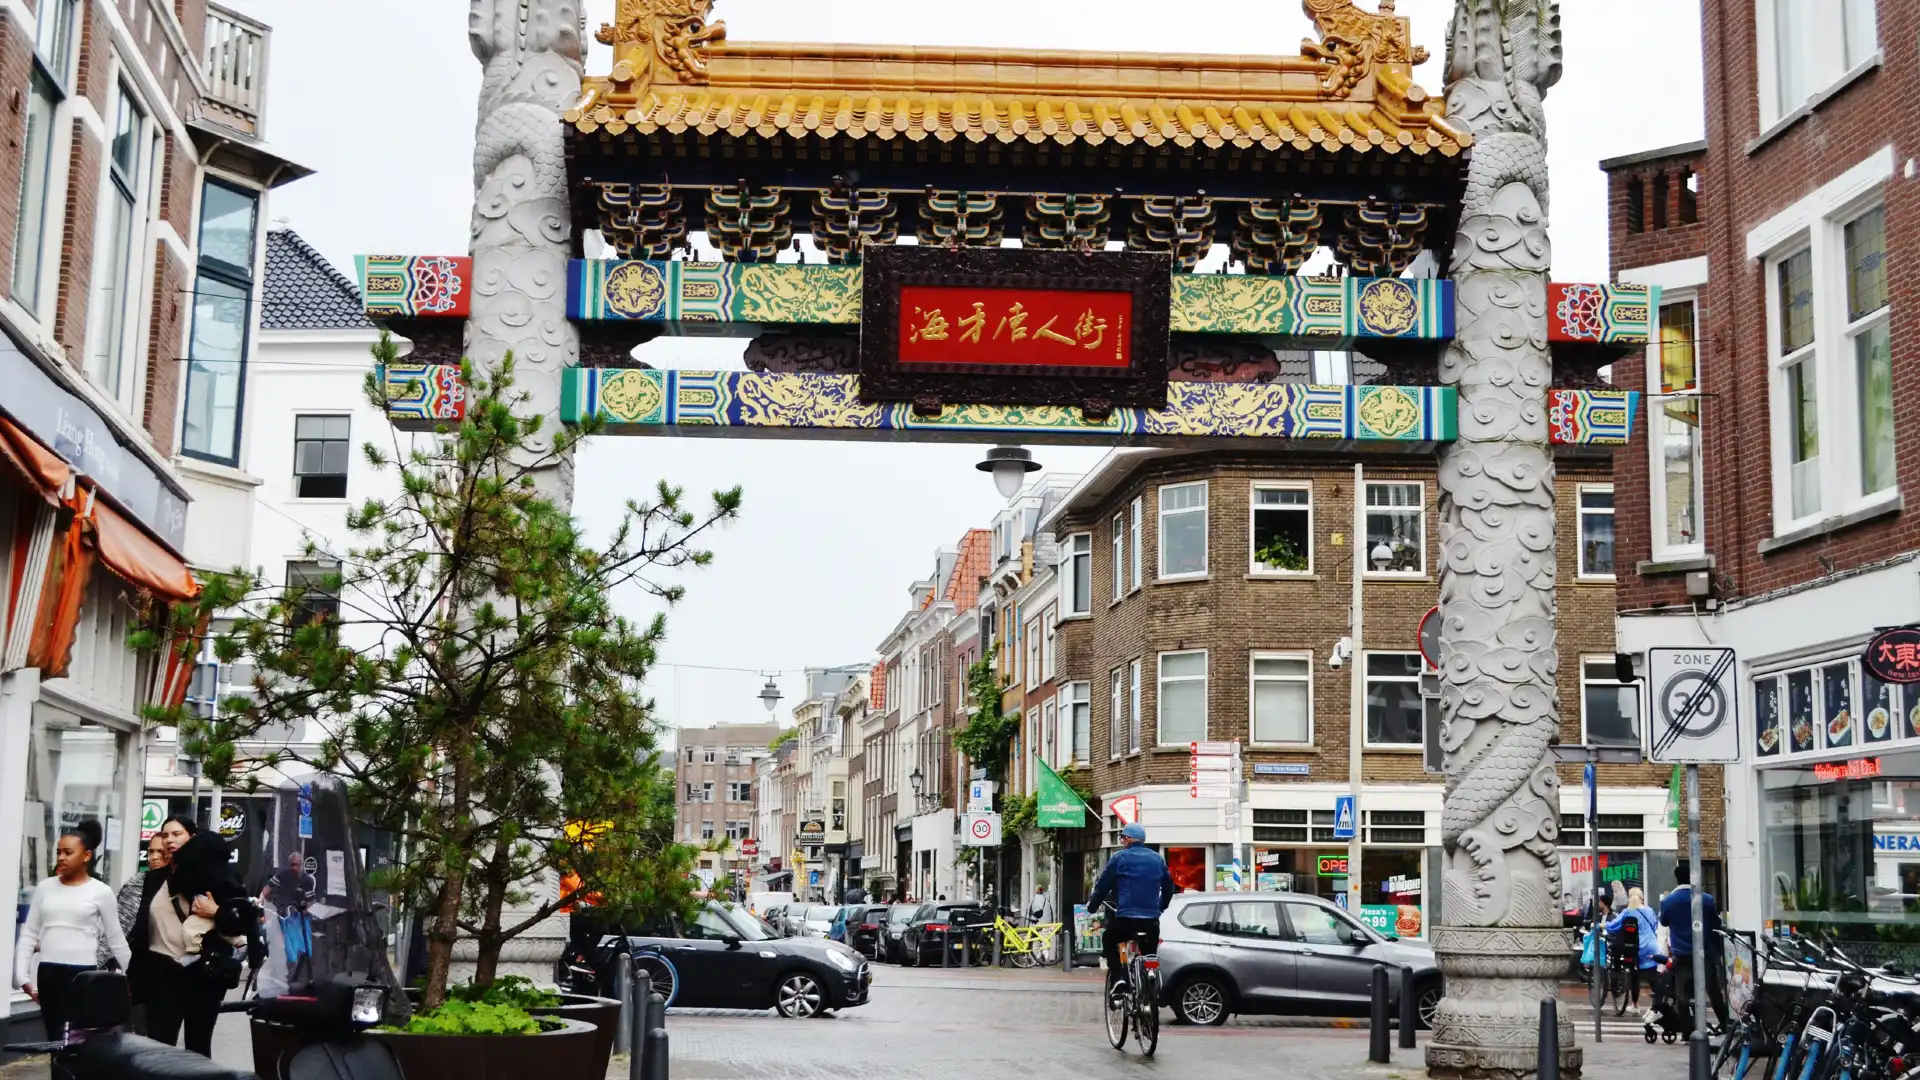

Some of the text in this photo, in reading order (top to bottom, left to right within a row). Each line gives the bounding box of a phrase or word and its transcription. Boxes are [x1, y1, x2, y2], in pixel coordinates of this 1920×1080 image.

[909, 301, 1108, 350] 海牙唐人街
[56, 407, 84, 456] Liang
[1673, 654, 1712, 665] ZONE
[1878, 640, 1920, 671] 大東
[1673, 691, 1715, 717] 30
[975, 824, 989, 833] 30
[1320, 860, 1348, 871] OPE
[1602, 864, 1639, 882] TASTY!
